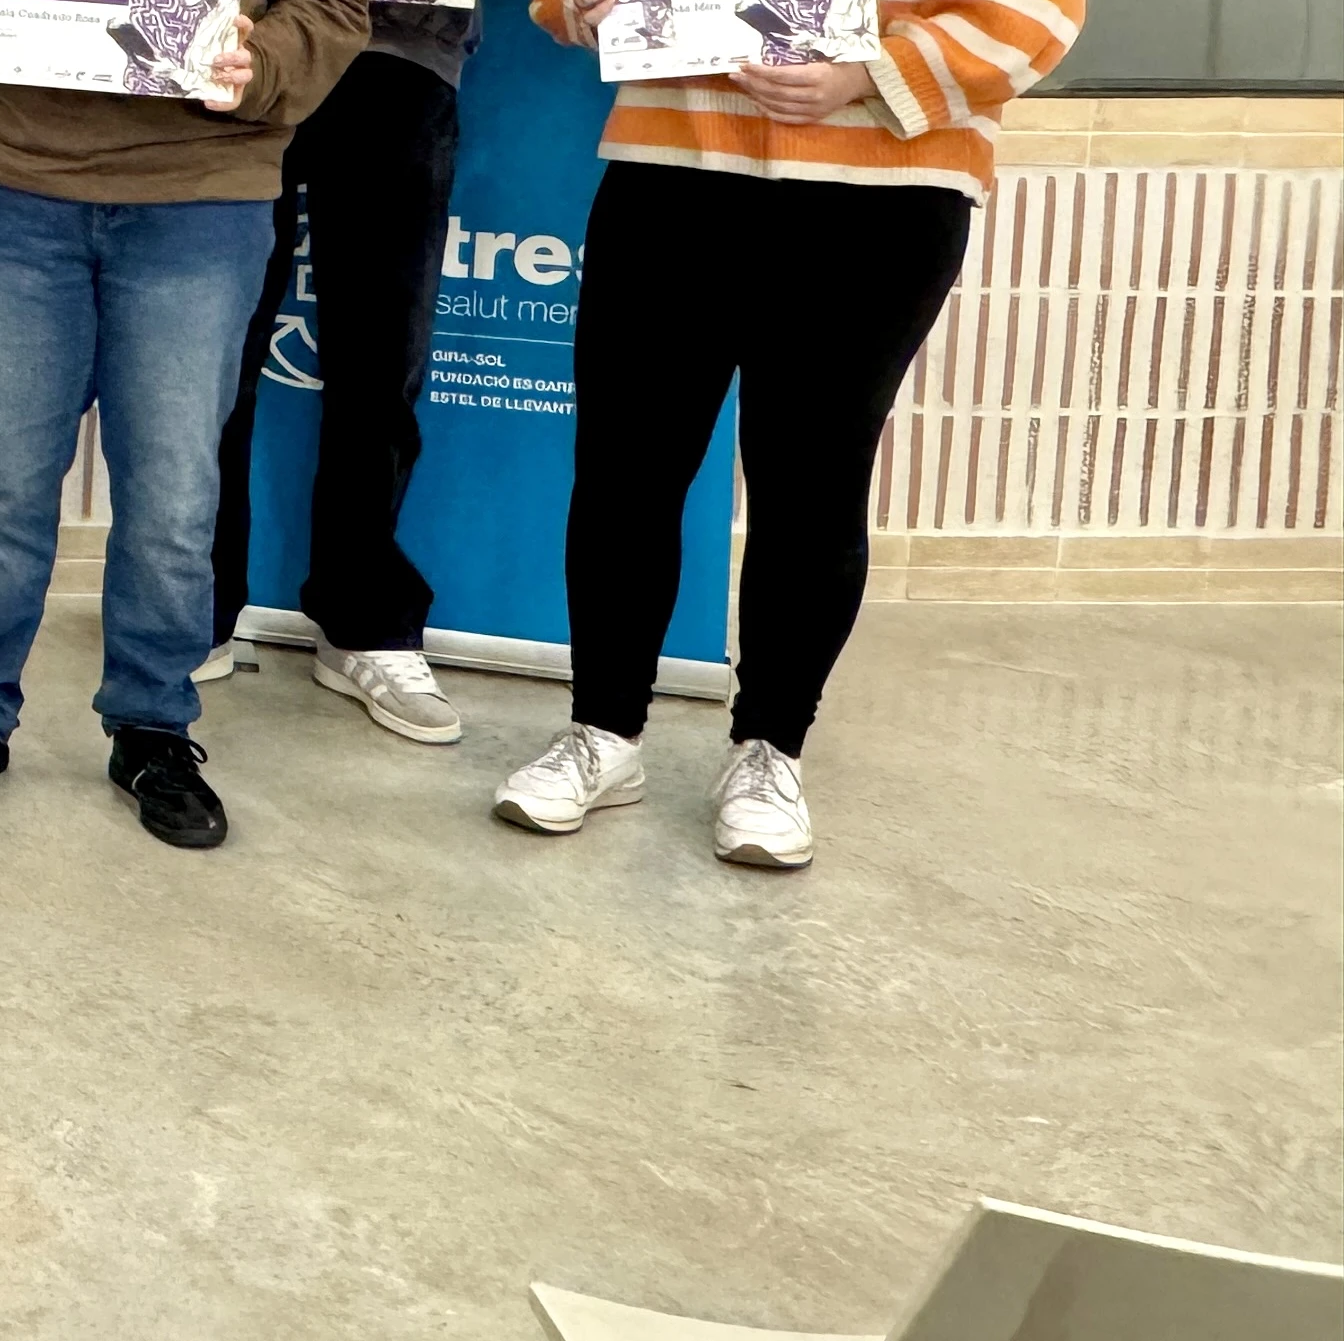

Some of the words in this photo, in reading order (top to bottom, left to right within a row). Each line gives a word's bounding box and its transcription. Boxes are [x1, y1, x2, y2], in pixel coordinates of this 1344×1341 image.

[435, 290, 509, 321] salut
[432, 349, 507, 367] GIRA-SOL
[431, 371, 510, 389] FUNDACIÓ
[513, 377, 532, 390] ES
[430, 391, 477, 407] ESTEL
[480, 395, 501, 408] DE
[505, 398, 575, 415] LLEVANT
